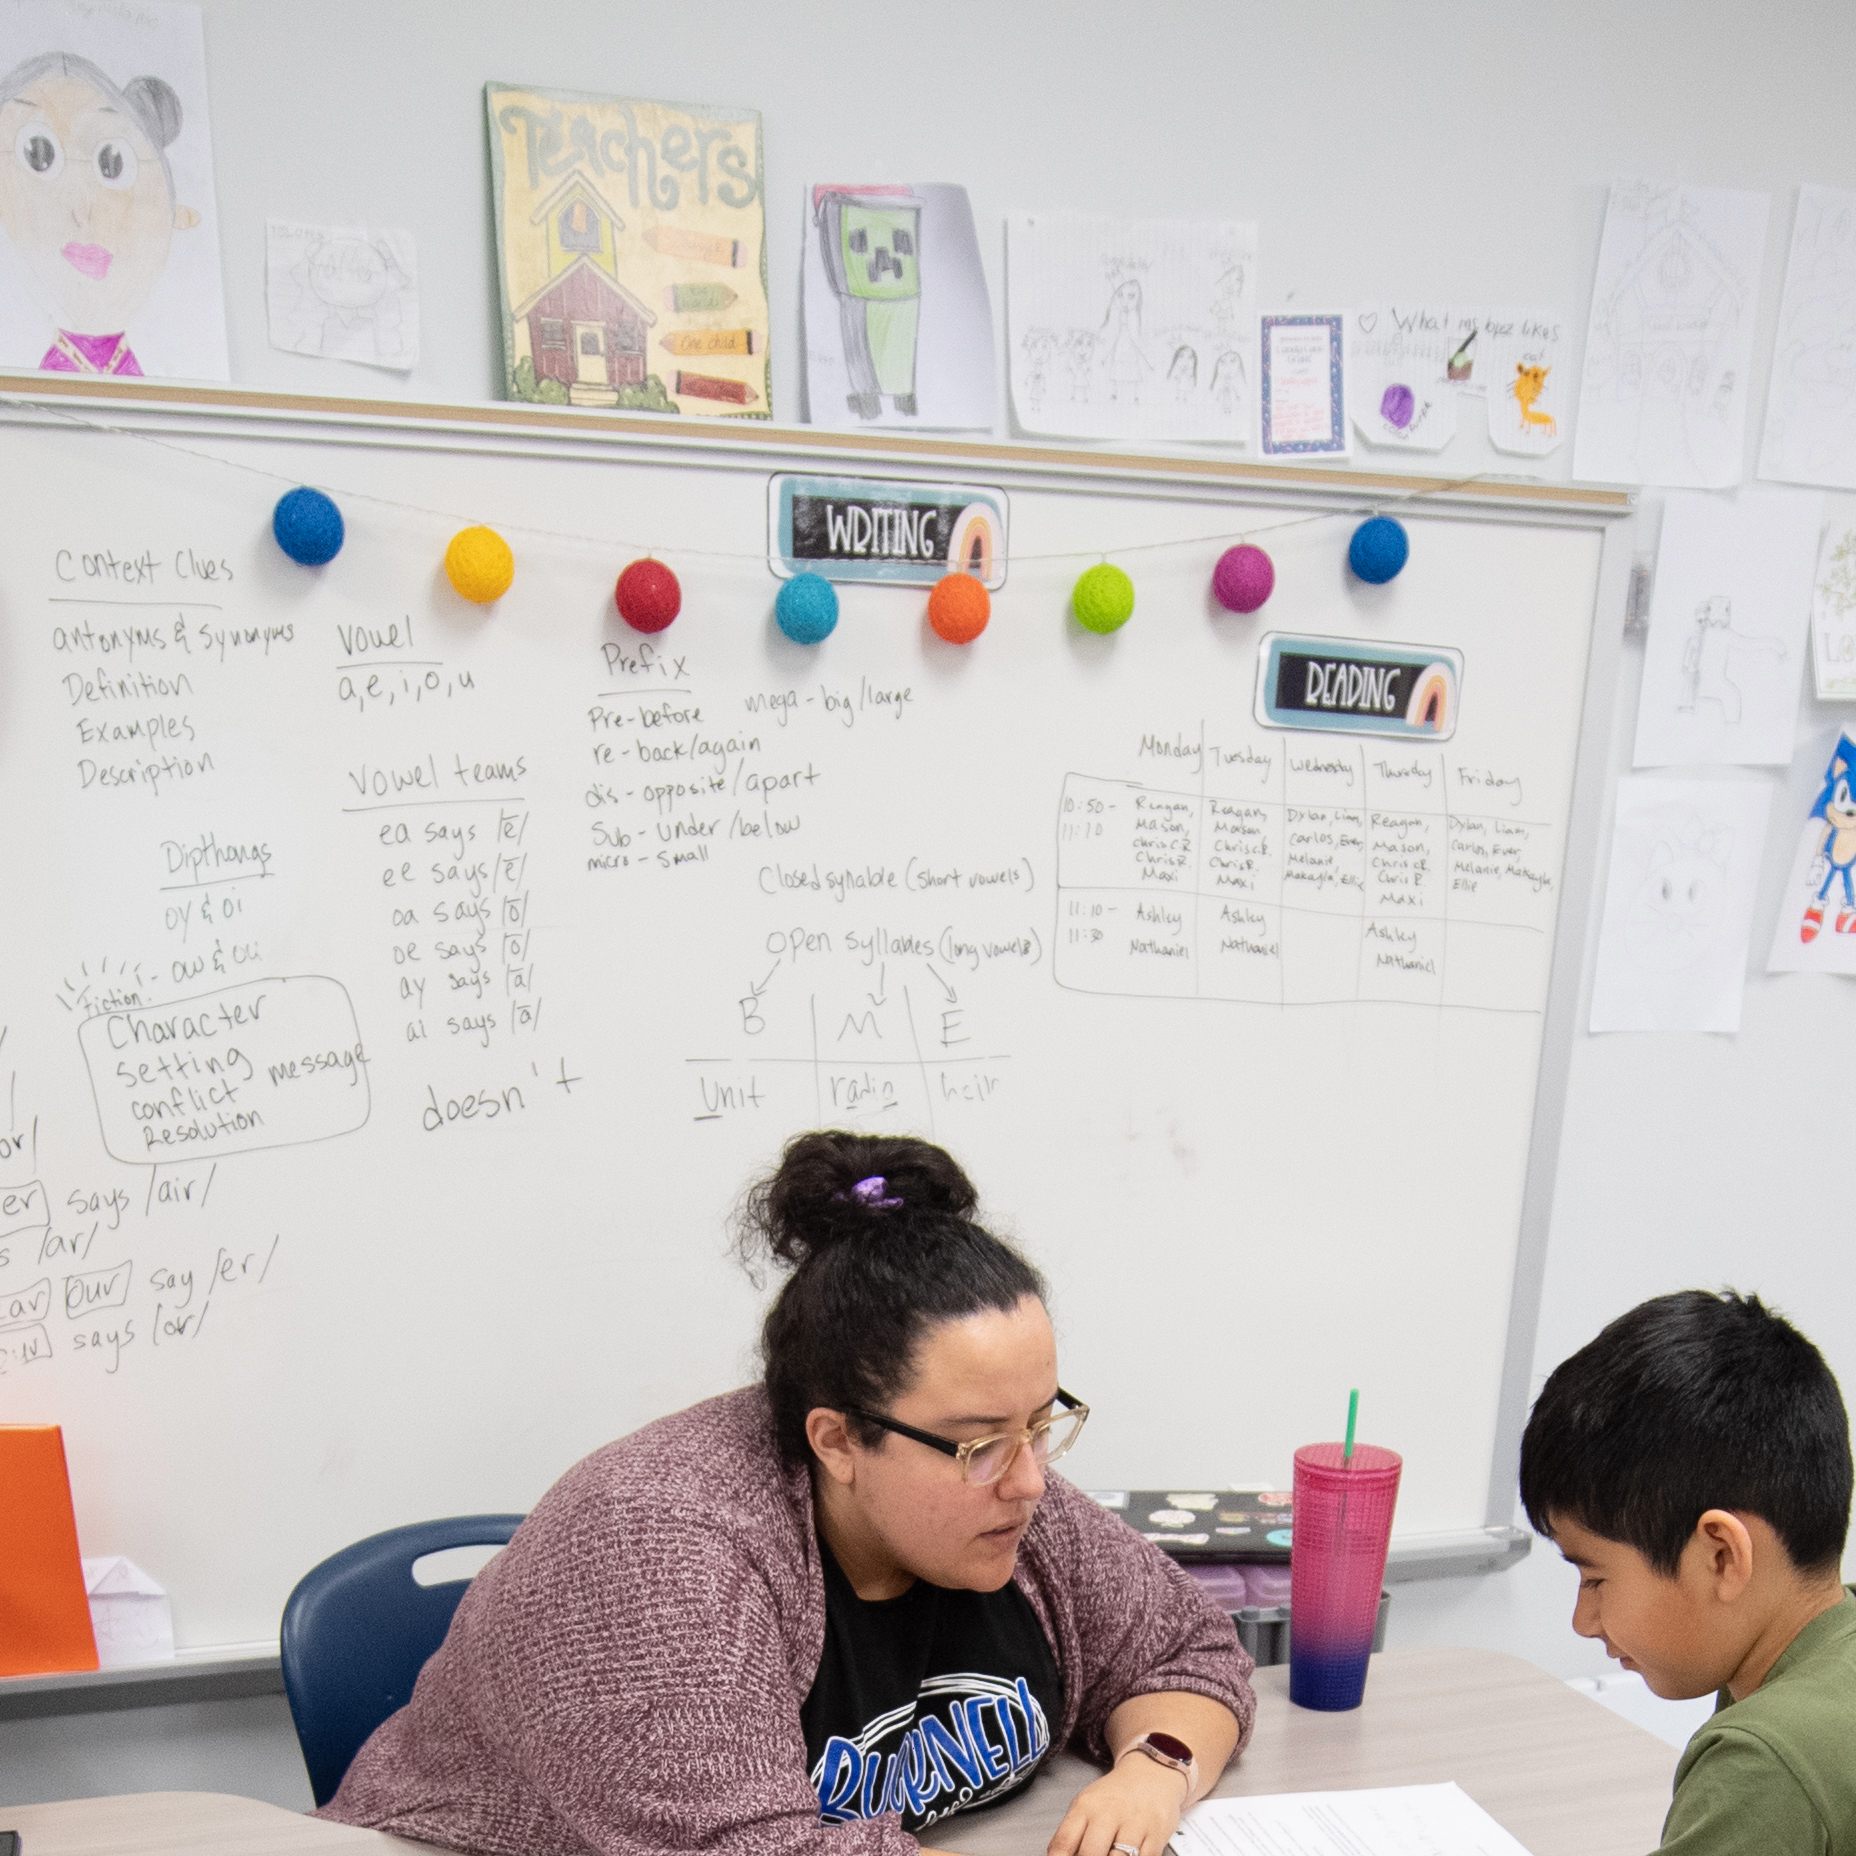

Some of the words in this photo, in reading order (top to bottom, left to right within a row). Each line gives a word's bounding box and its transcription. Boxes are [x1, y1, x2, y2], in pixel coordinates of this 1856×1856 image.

[500, 104, 757, 211] Teachers
[827, 505, 937, 557] WRITING
[56, 549, 162, 584] Context
[175, 548, 233, 580] Clues
[53, 619, 166, 662] antonyms
[601, 642, 691, 680] Prefix
[61, 666, 193, 706] Definition
[1306, 661, 1400, 712] READING
[76, 713, 195, 751] Examples
[77, 752, 215, 796] Description
[454, 753, 527, 787] teams
[1138, 732, 1203, 774] Monday
[1209, 744, 1272, 785] Tuesday
[1458, 766, 1523, 807] Friday
[379, 822, 410, 845] ea
[425, 822, 475, 860] says
[383, 862, 415, 887] ee
[432, 862, 488, 898] says
[392, 907, 419, 926] oa
[433, 898, 491, 936] says
[107, 994, 268, 1050] Character
[406, 1019, 427, 1042] ai
[447, 1013, 496, 1048] says
[739, 996, 766, 1035] B
[837, 1010, 883, 1042] M
[940, 1009, 972, 1048] E
[143, 1109, 266, 1152] Resolution
[2, 1189, 38, 1216] er
[67, 1186, 130, 1230] says
